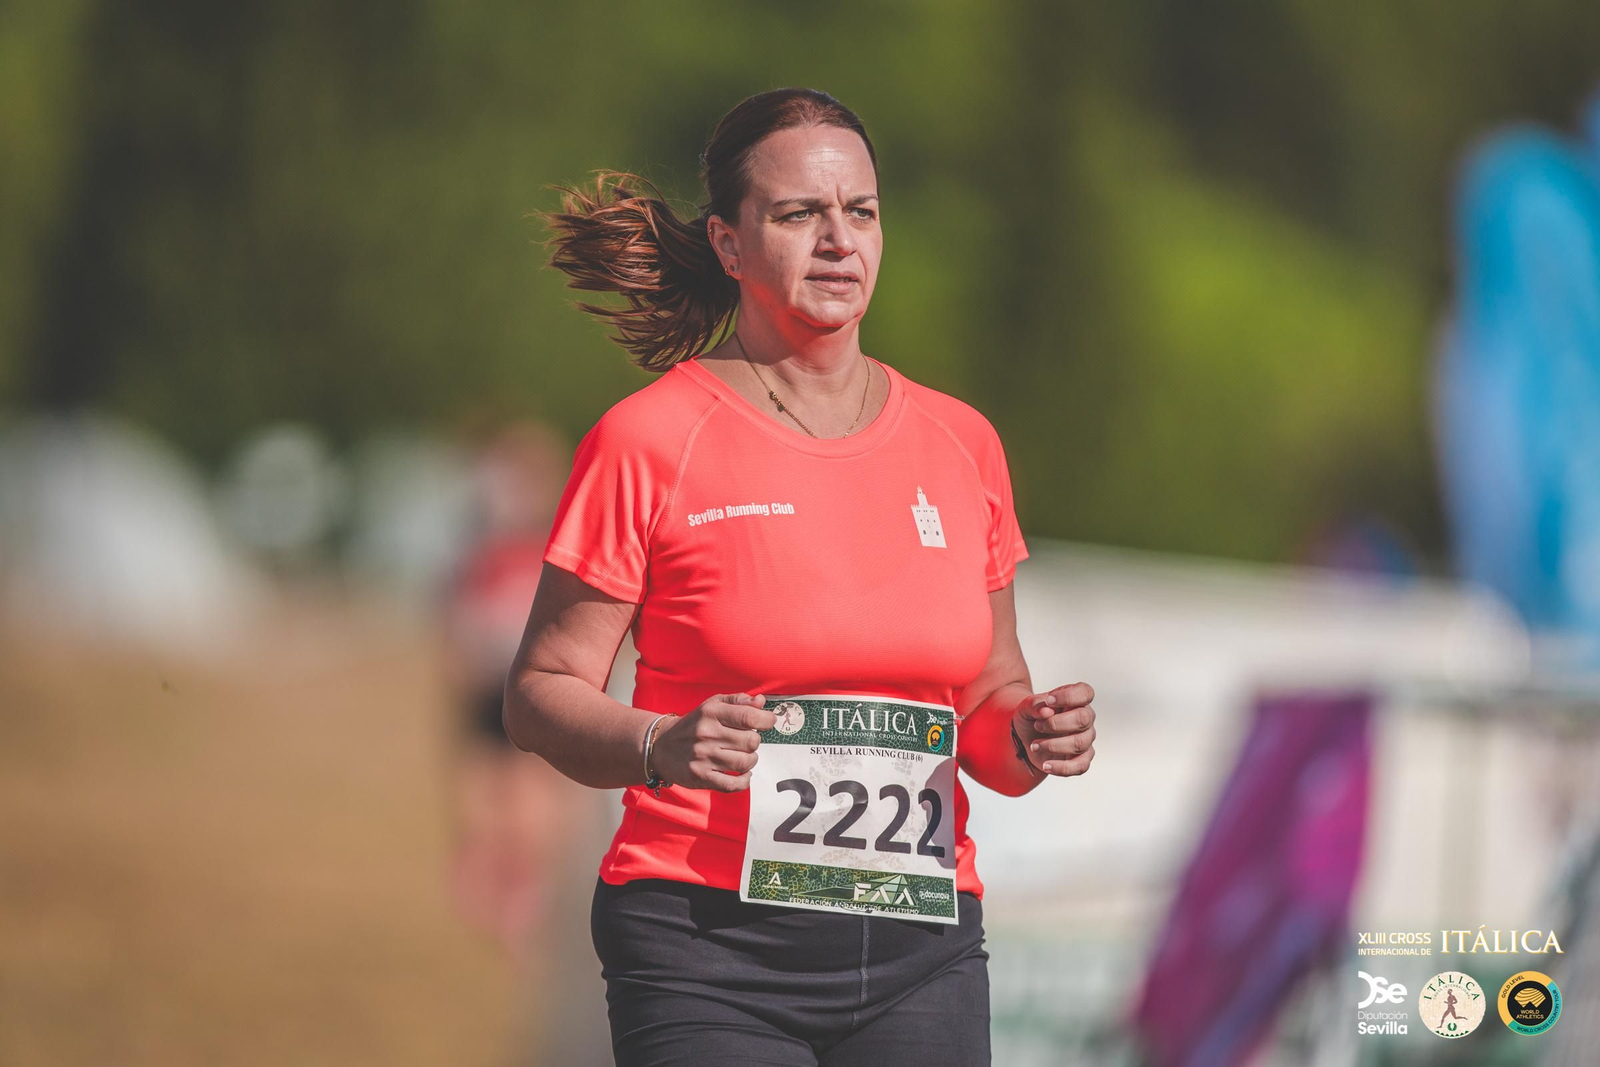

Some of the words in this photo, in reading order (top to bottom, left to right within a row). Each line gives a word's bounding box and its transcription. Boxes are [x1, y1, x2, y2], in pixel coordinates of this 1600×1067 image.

[687, 508, 724, 527] Sevilla
[725, 502, 770, 518] Running
[771, 502, 795, 515] Club
[821, 702, 918, 736] ITÁLICA
[878, 733, 897, 741] CROSS
[809, 746, 853, 756] SEVILLA
[855, 748, 897, 759] RUNNING
[897, 751, 915, 761] CLUB
[915, 754, 924, 763] (6)
[773, 778, 946, 859] 2222
[789, 896, 833, 907] FEDERACIÓN
[884, 907, 920, 916] ATLETISMO
